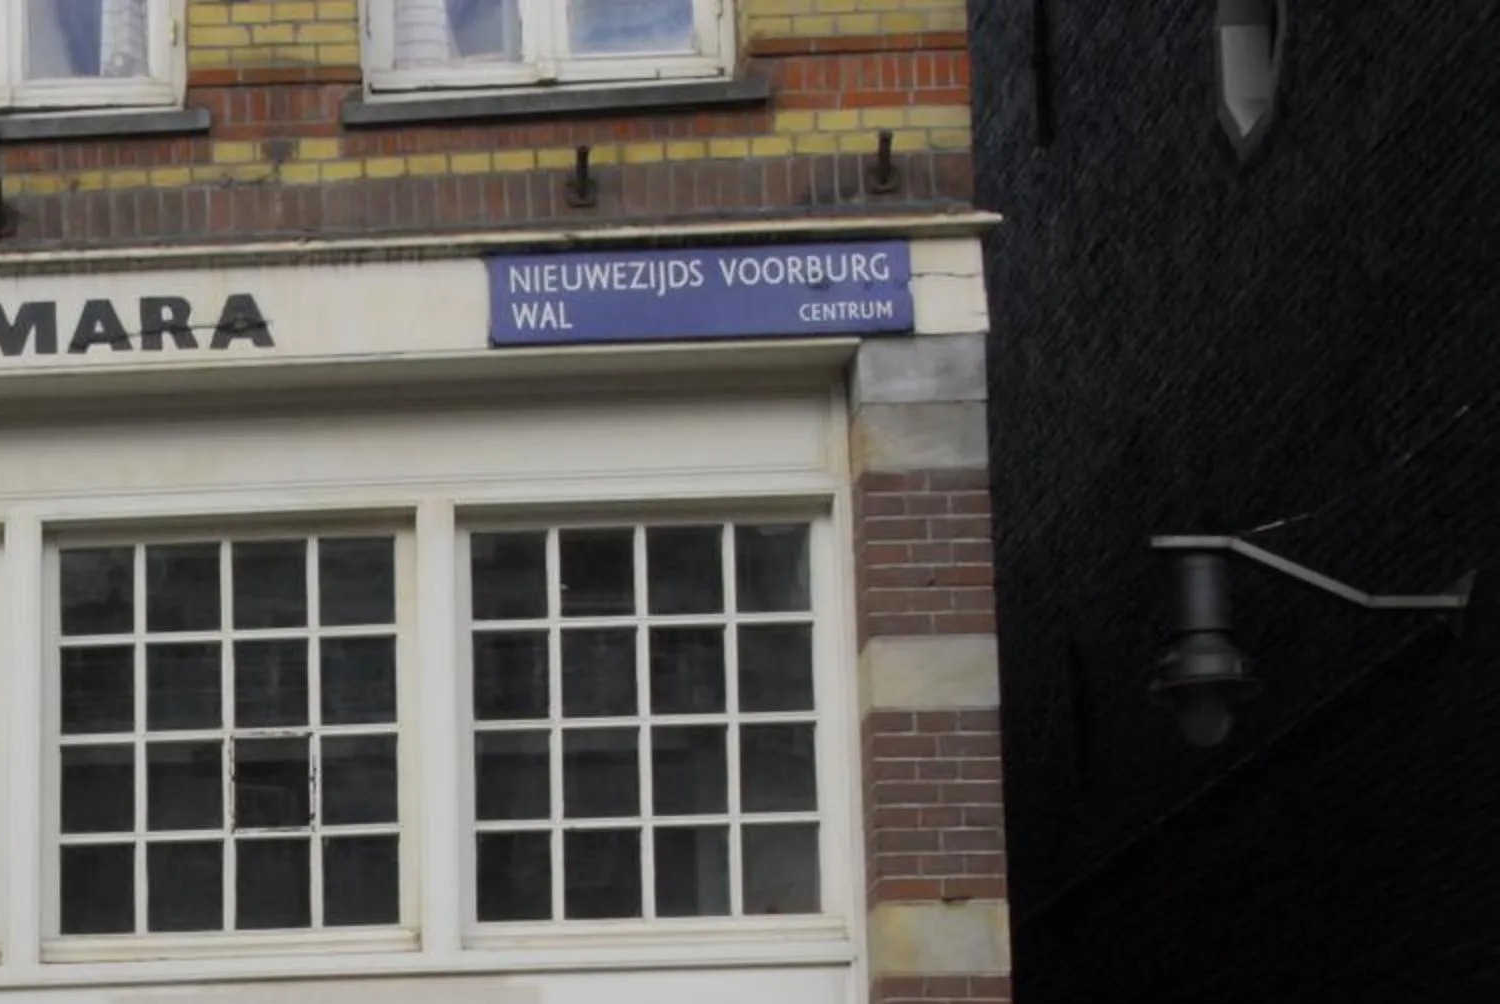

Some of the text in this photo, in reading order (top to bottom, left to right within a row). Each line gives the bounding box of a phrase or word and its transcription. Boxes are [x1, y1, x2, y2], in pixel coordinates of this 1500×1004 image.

[509, 252, 891, 296] NIEUWEZIJDS VOORBURG
[511, 301, 573, 330] WAL
[799, 299, 894, 322] CENTRUM
